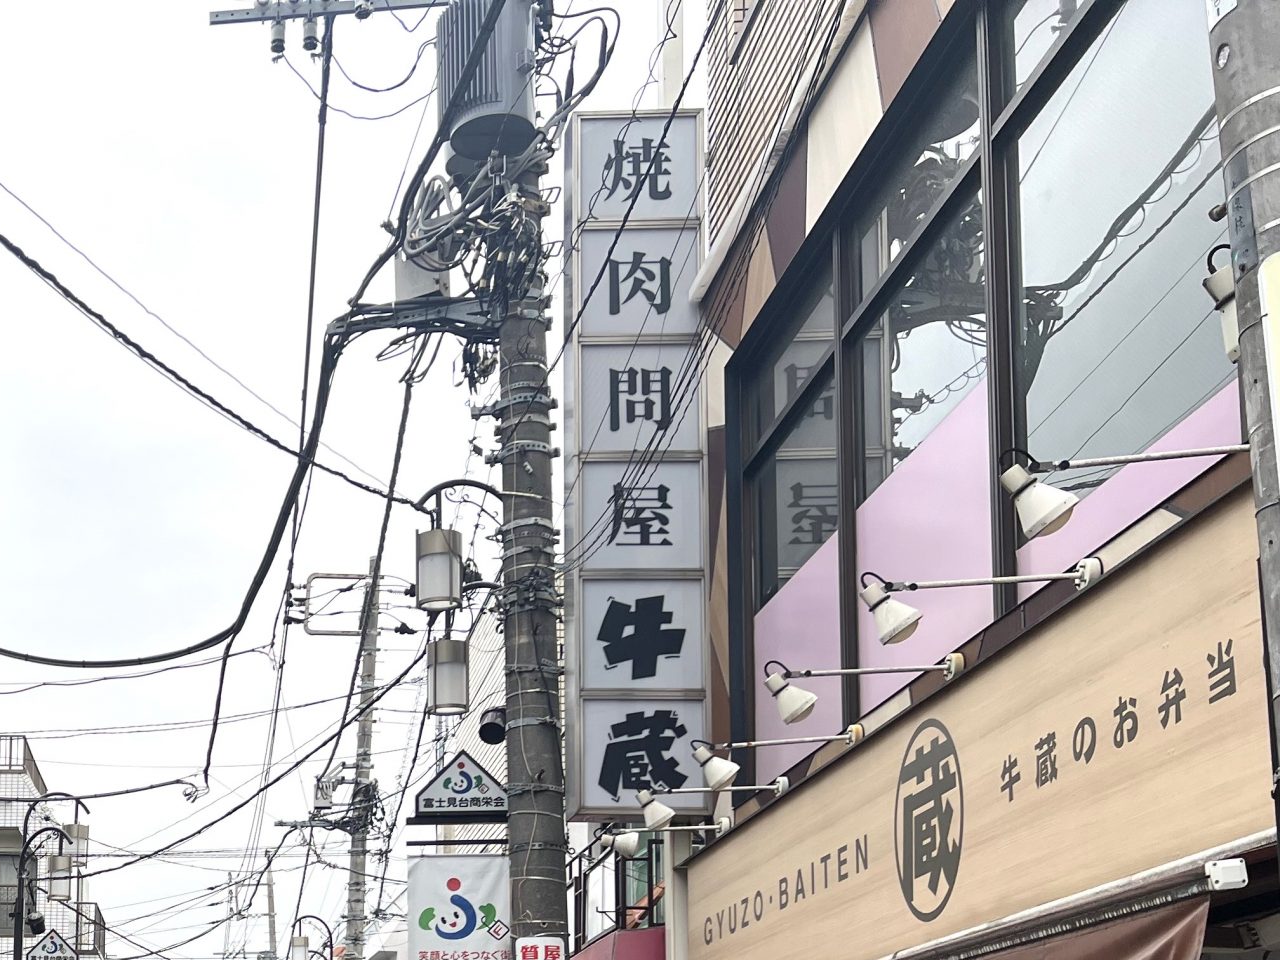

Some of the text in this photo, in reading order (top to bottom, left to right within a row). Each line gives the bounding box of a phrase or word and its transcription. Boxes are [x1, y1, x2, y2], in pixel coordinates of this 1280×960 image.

[999, 638, 1237, 803] 牛蔵のお弁当
[423, 796, 505, 808] 富士見台商栄会
[899, 733, 962, 906] 蔵
[418, 950, 512, 960] 笑顔と心をつなぐ街
